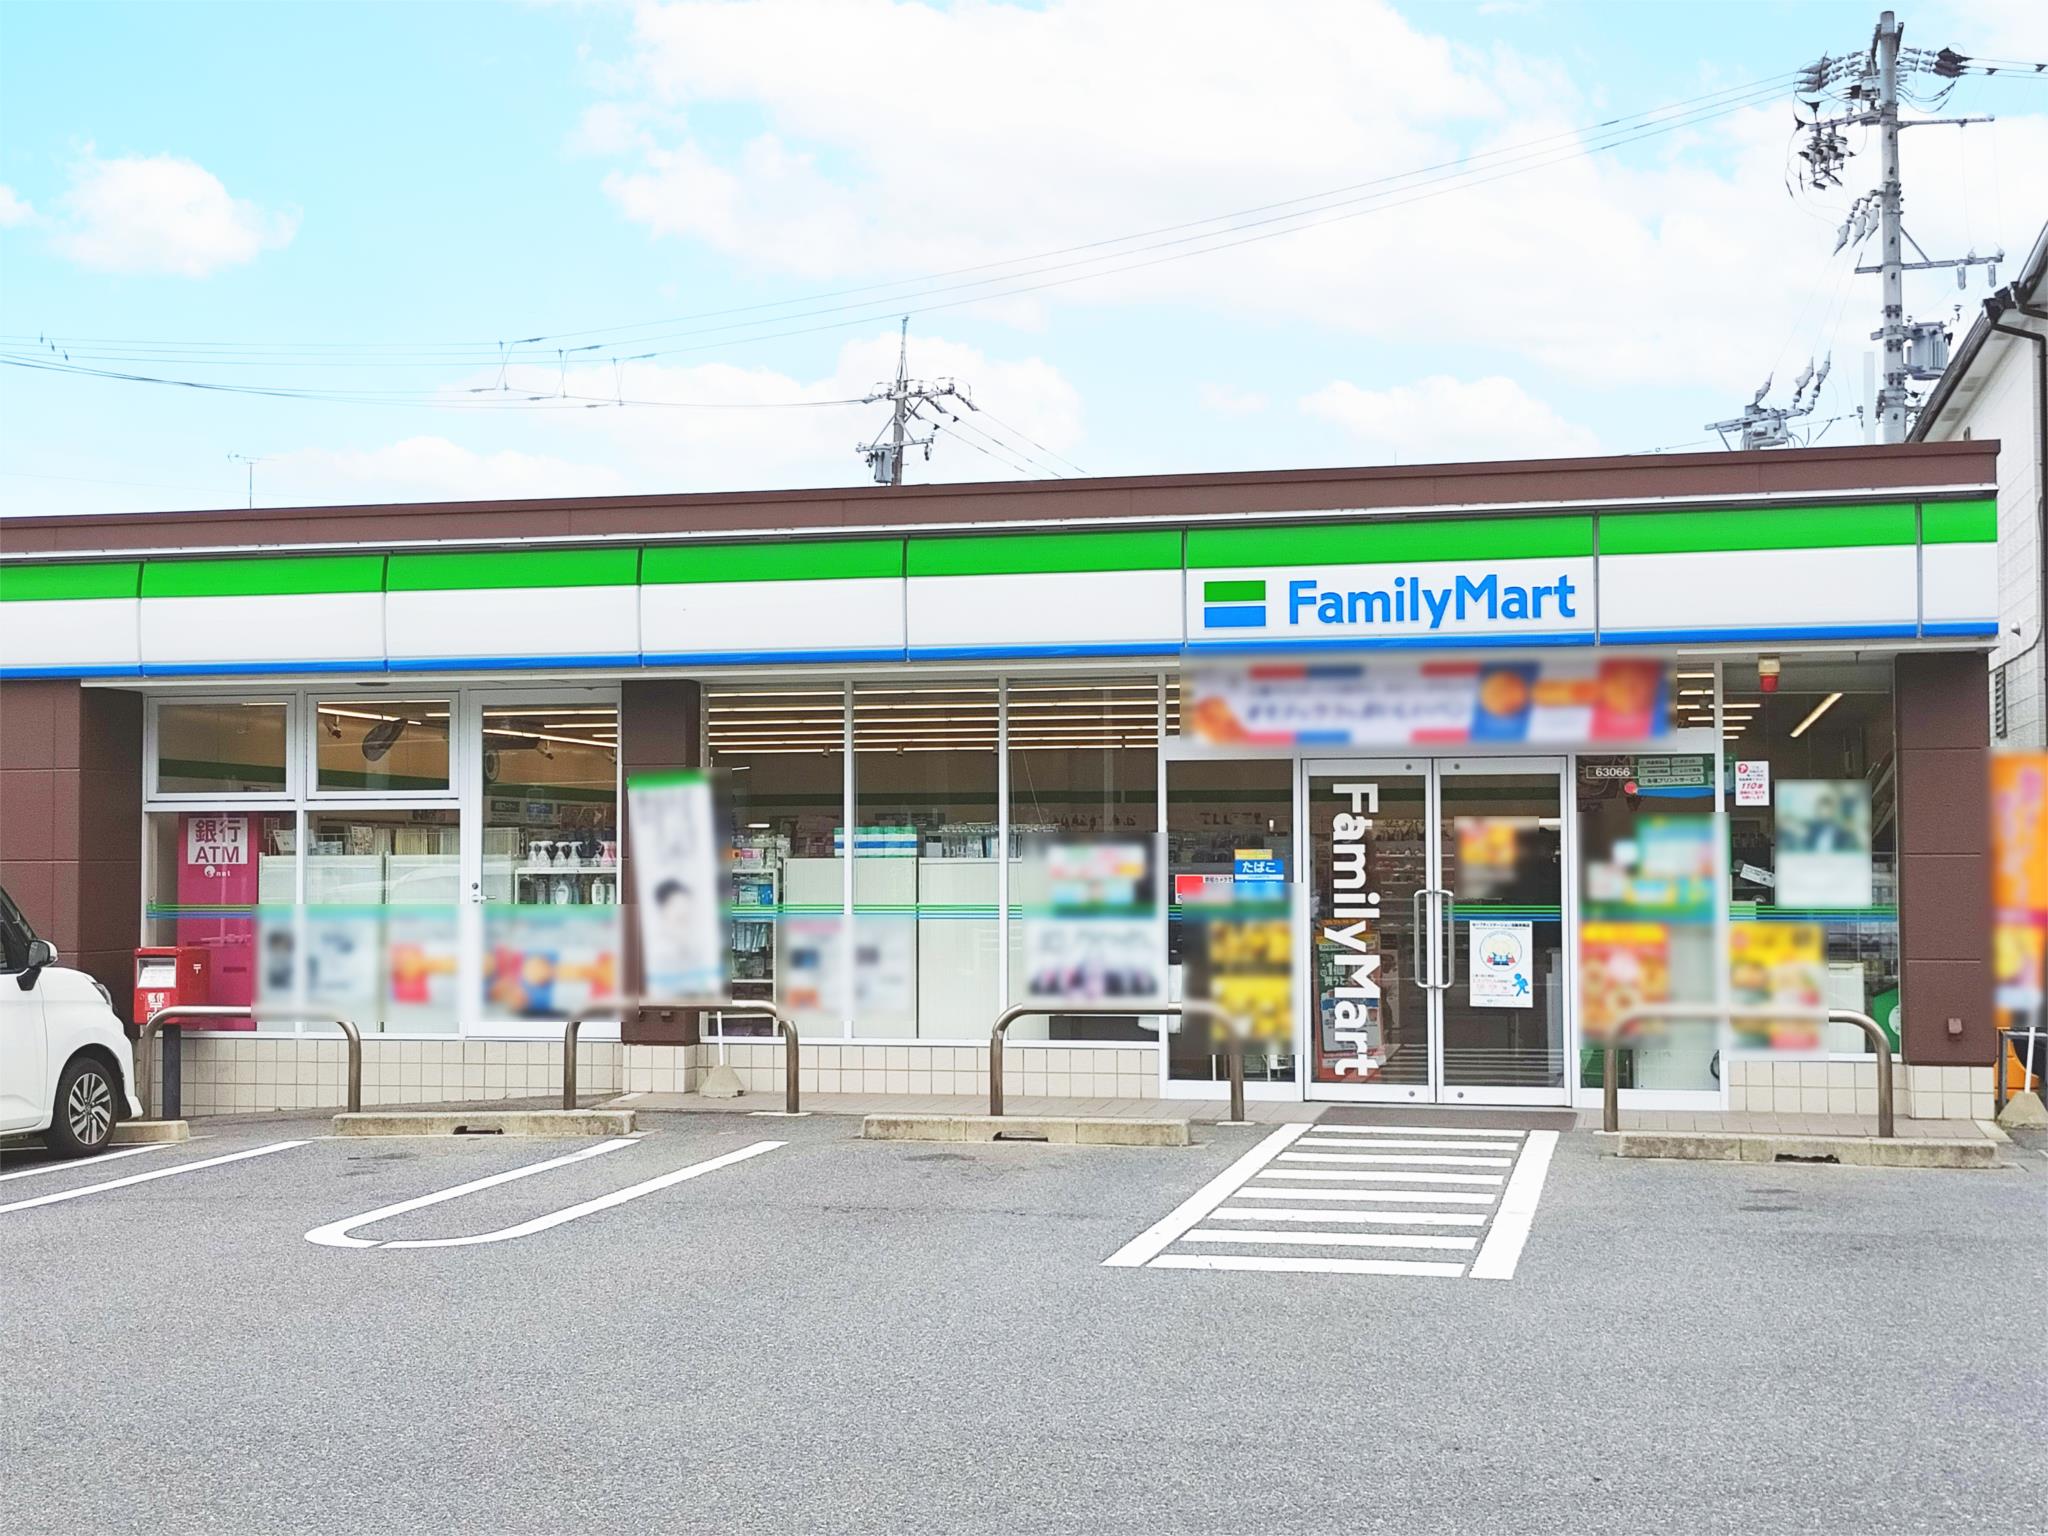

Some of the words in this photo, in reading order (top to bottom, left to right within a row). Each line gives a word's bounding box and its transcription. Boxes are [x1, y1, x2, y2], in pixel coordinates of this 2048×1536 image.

[1288, 574, 1576, 629] FamilyMart
[1595, 767, 1631, 777] 63066
[195, 819, 242, 844] 銀行
[195, 846, 241, 863] ATM
[1242, 861, 1277, 874] たばこ
[1324, 783, 1381, 1076] FamilyMart
